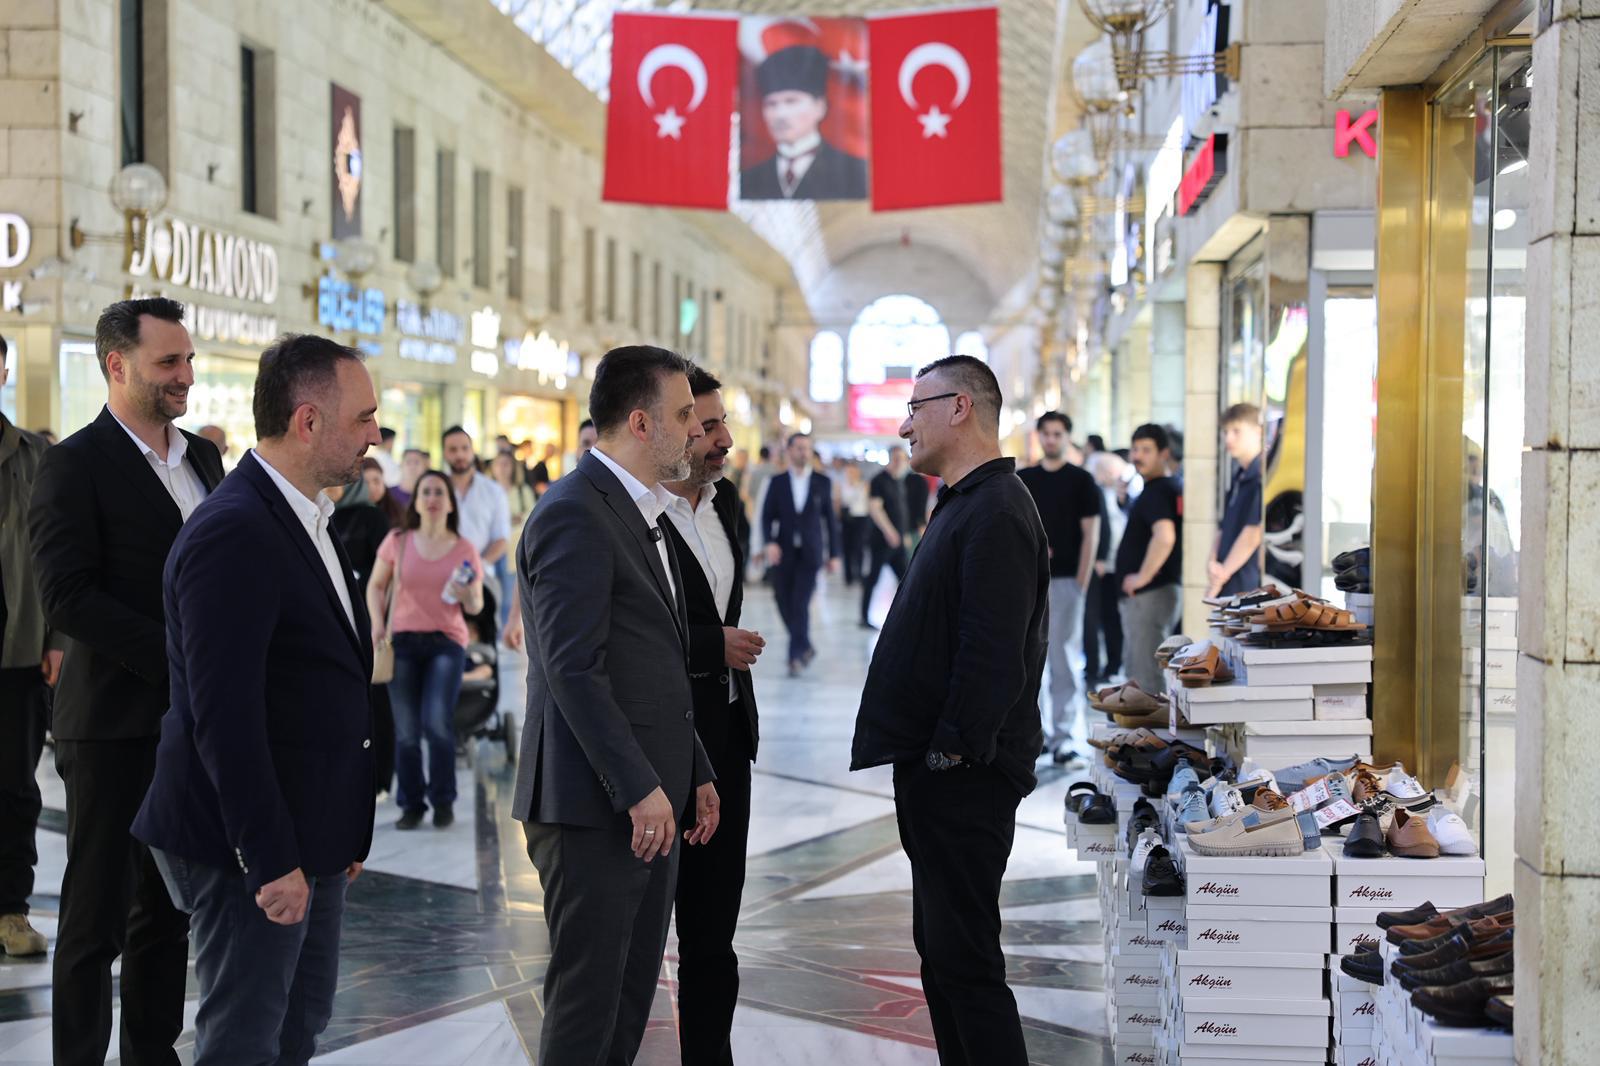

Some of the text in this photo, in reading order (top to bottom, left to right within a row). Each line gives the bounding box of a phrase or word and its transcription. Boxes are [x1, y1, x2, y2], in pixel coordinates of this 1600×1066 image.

[171, 219, 278, 304] DIAMOND
[1195, 882, 1239, 897] Akgün
[1349, 886, 1392, 901] Akgün
[1197, 928, 1240, 944] Akgün
[1123, 974, 1160, 987] Akgün
[1189, 974, 1232, 989] Akgün
[1126, 1013, 1162, 1026] Akgün
[1194, 1021, 1237, 1037] Akgün
